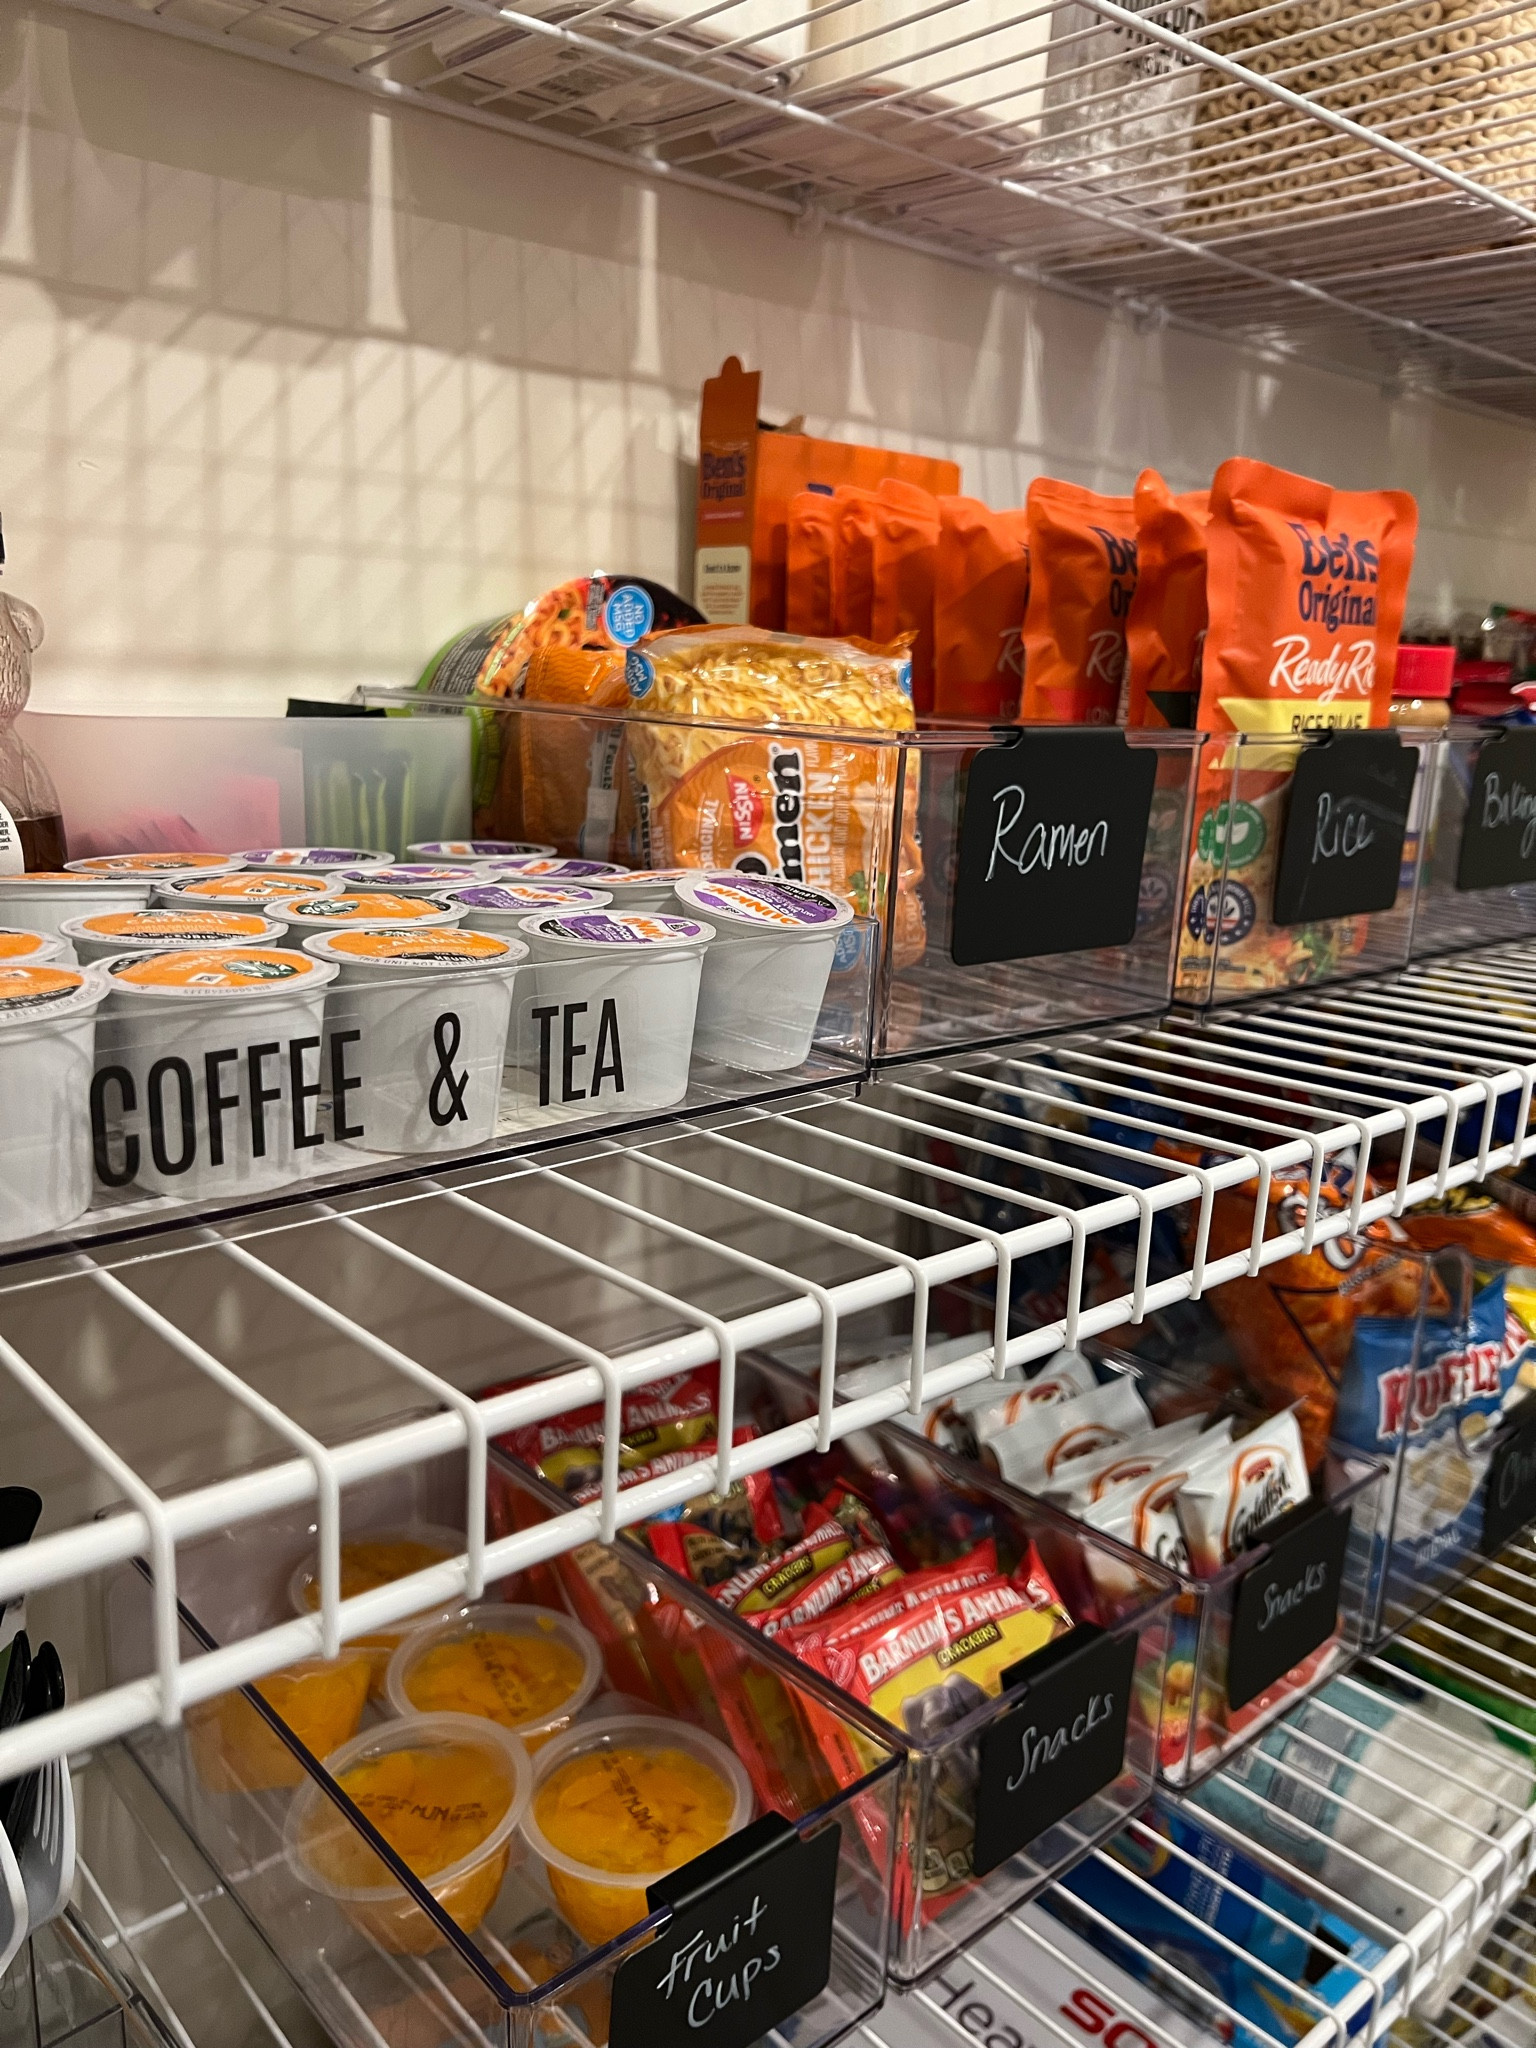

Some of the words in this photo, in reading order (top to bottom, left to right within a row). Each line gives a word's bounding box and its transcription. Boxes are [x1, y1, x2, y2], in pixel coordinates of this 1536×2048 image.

[612, 602, 624, 632] MSG
[622, 593, 636, 638] ADDED
[634, 604, 645, 625] NO
[1299, 579, 1377, 633] Origina
[702, 799, 720, 870] ORIGINAL
[733, 781, 754, 841] NISSIN
[805, 772, 835, 886] HICKEN
[984, 784, 1109, 882] Ramen
[1312, 792, 1375, 864] Rice
[376, 937, 472, 950] CARAMEL
[383, 958, 409, 966] UNIT
[89, 1029, 365, 1188] COFFEE
[428, 1011, 469, 1127] &
[531, 997, 625, 1107] TEA
[762, 1553, 813, 1595] CRACKERS
[1256, 1561, 1328, 1633] Snacks
[858, 1607, 964, 1687] BARNUM'S
[936, 1623, 998, 1666] CRACKERS
[1006, 1693, 1115, 1792] Snacks
[656, 1895, 768, 2000] Fruit
[687, 1944, 782, 2028] Cups
